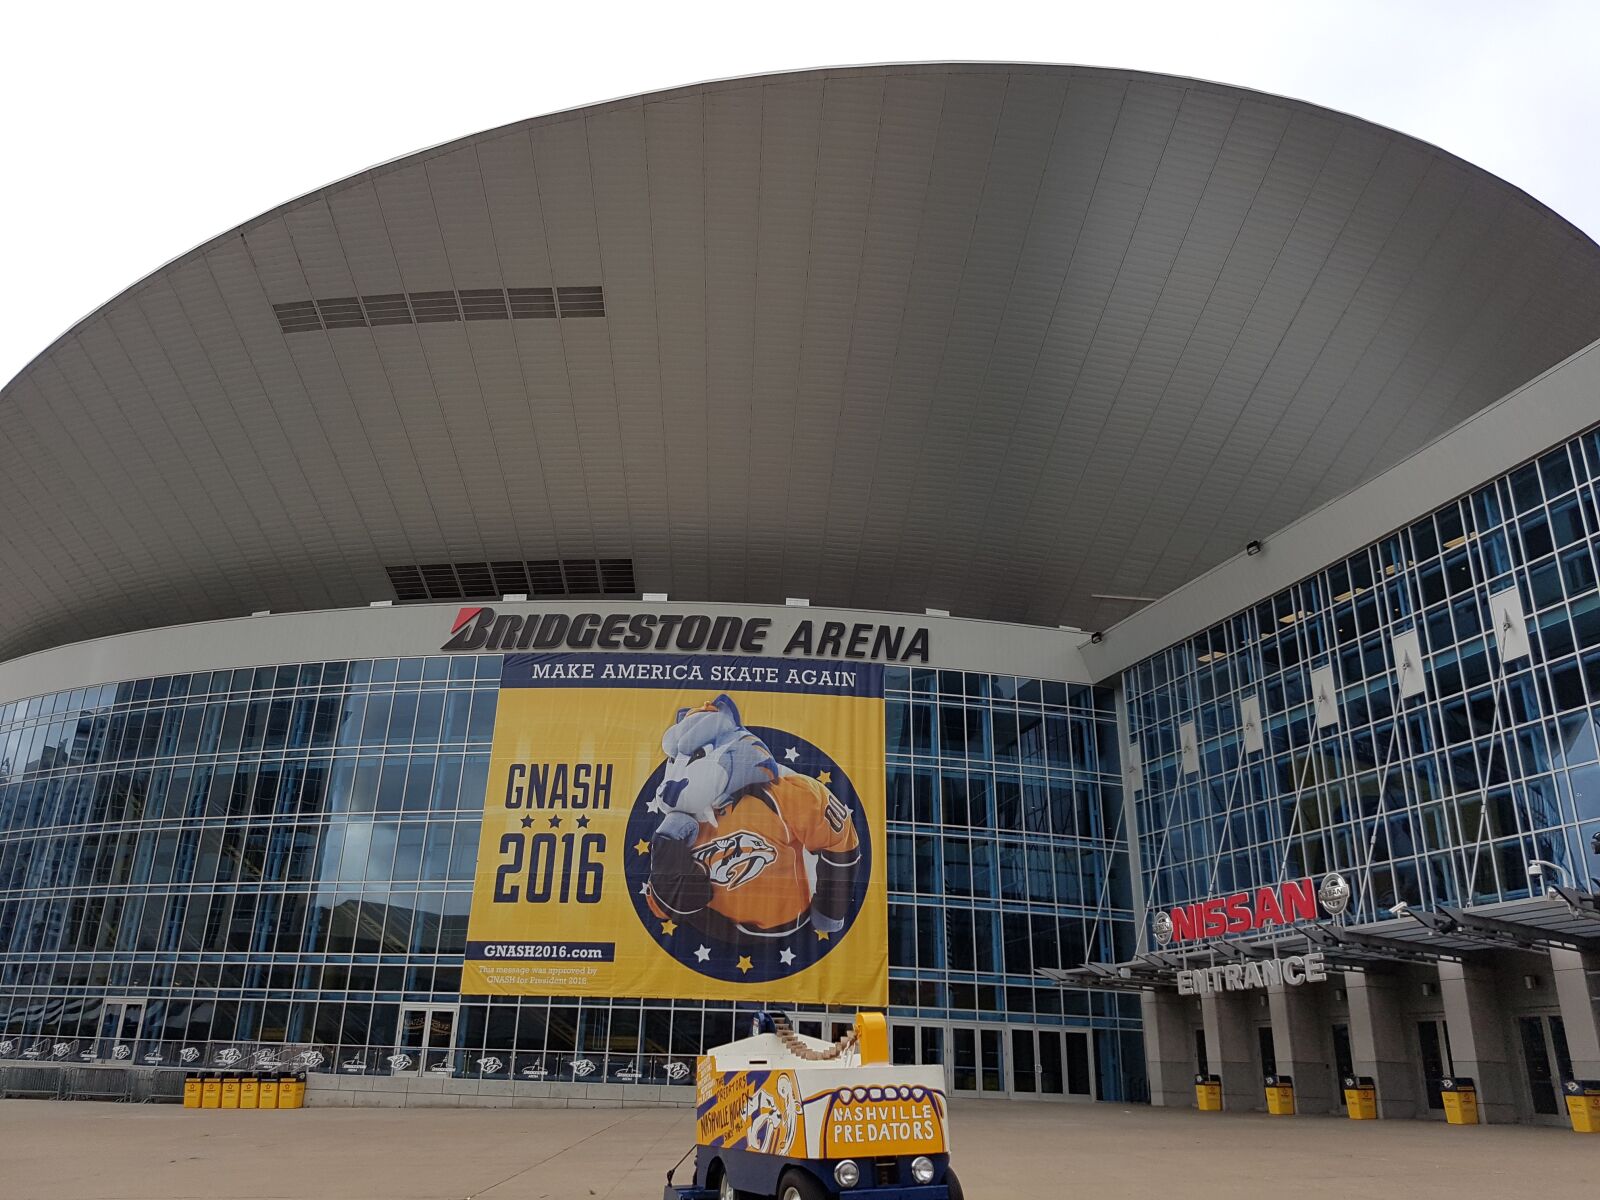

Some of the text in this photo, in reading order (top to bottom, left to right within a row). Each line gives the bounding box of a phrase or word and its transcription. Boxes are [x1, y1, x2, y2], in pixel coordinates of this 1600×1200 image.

[440, 607, 930, 663] BRIDGESTONE ARENA
[532, 664, 857, 687] MAKE AMERICA SKATE AGAIN
[505, 763, 613, 810] GNASH
[493, 833, 606, 904] 2016
[1170, 876, 1318, 942] NISSAN
[484, 945, 602, 959] GNASH2016.com
[479, 966, 494, 974] This
[496, 967, 529, 975] message
[548, 967, 585, 976] approved
[587, 967, 598, 976] by
[487, 976, 515, 984] GNASH
[517, 976, 529, 984] for
[529, 976, 567, 985] President
[1177, 952, 1327, 996] ENTRANCE
[700, 1105, 730, 1142] NASHVILLE
[834, 1105, 931, 1122] NASHVILLE
[834, 1120, 934, 1143] PREDATORS
